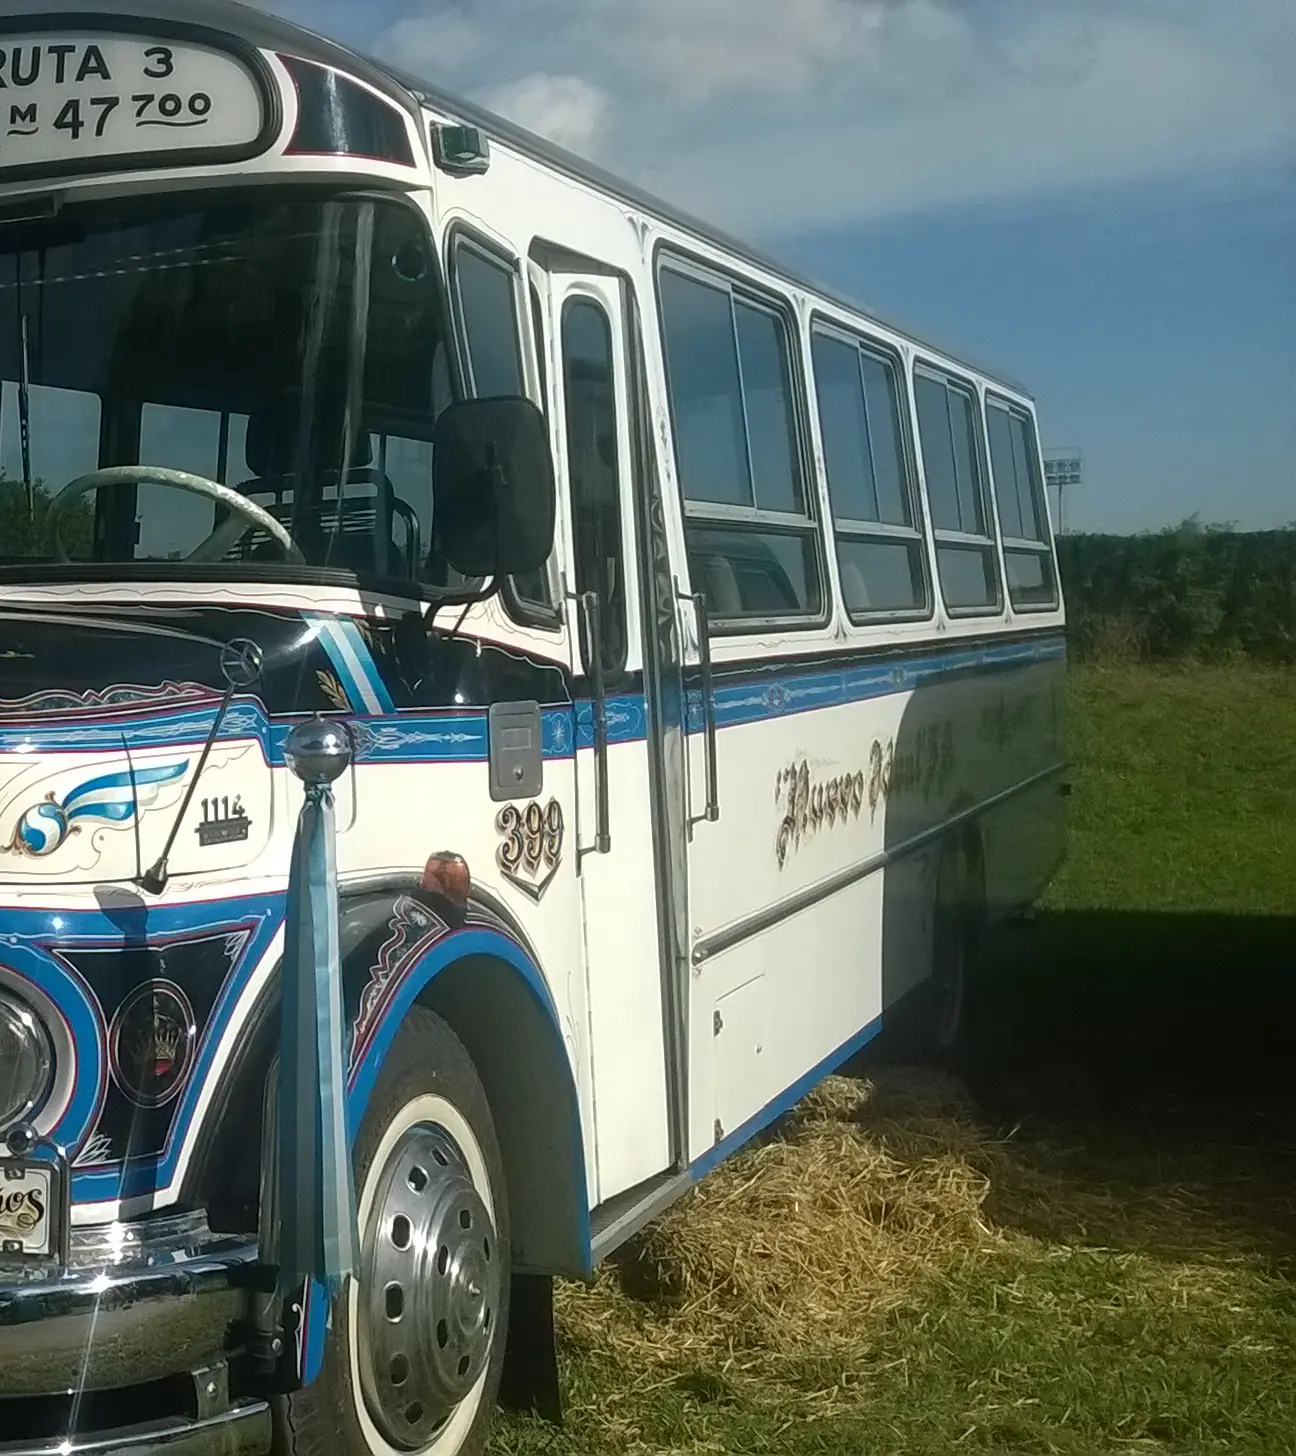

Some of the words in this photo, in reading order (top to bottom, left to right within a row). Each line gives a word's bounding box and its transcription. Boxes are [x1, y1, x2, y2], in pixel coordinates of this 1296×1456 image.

[142, 46, 174, 79] 3
[52, 95, 120, 140] 47
[200, 793, 246, 823] 1114
[494, 796, 564, 880] 399
